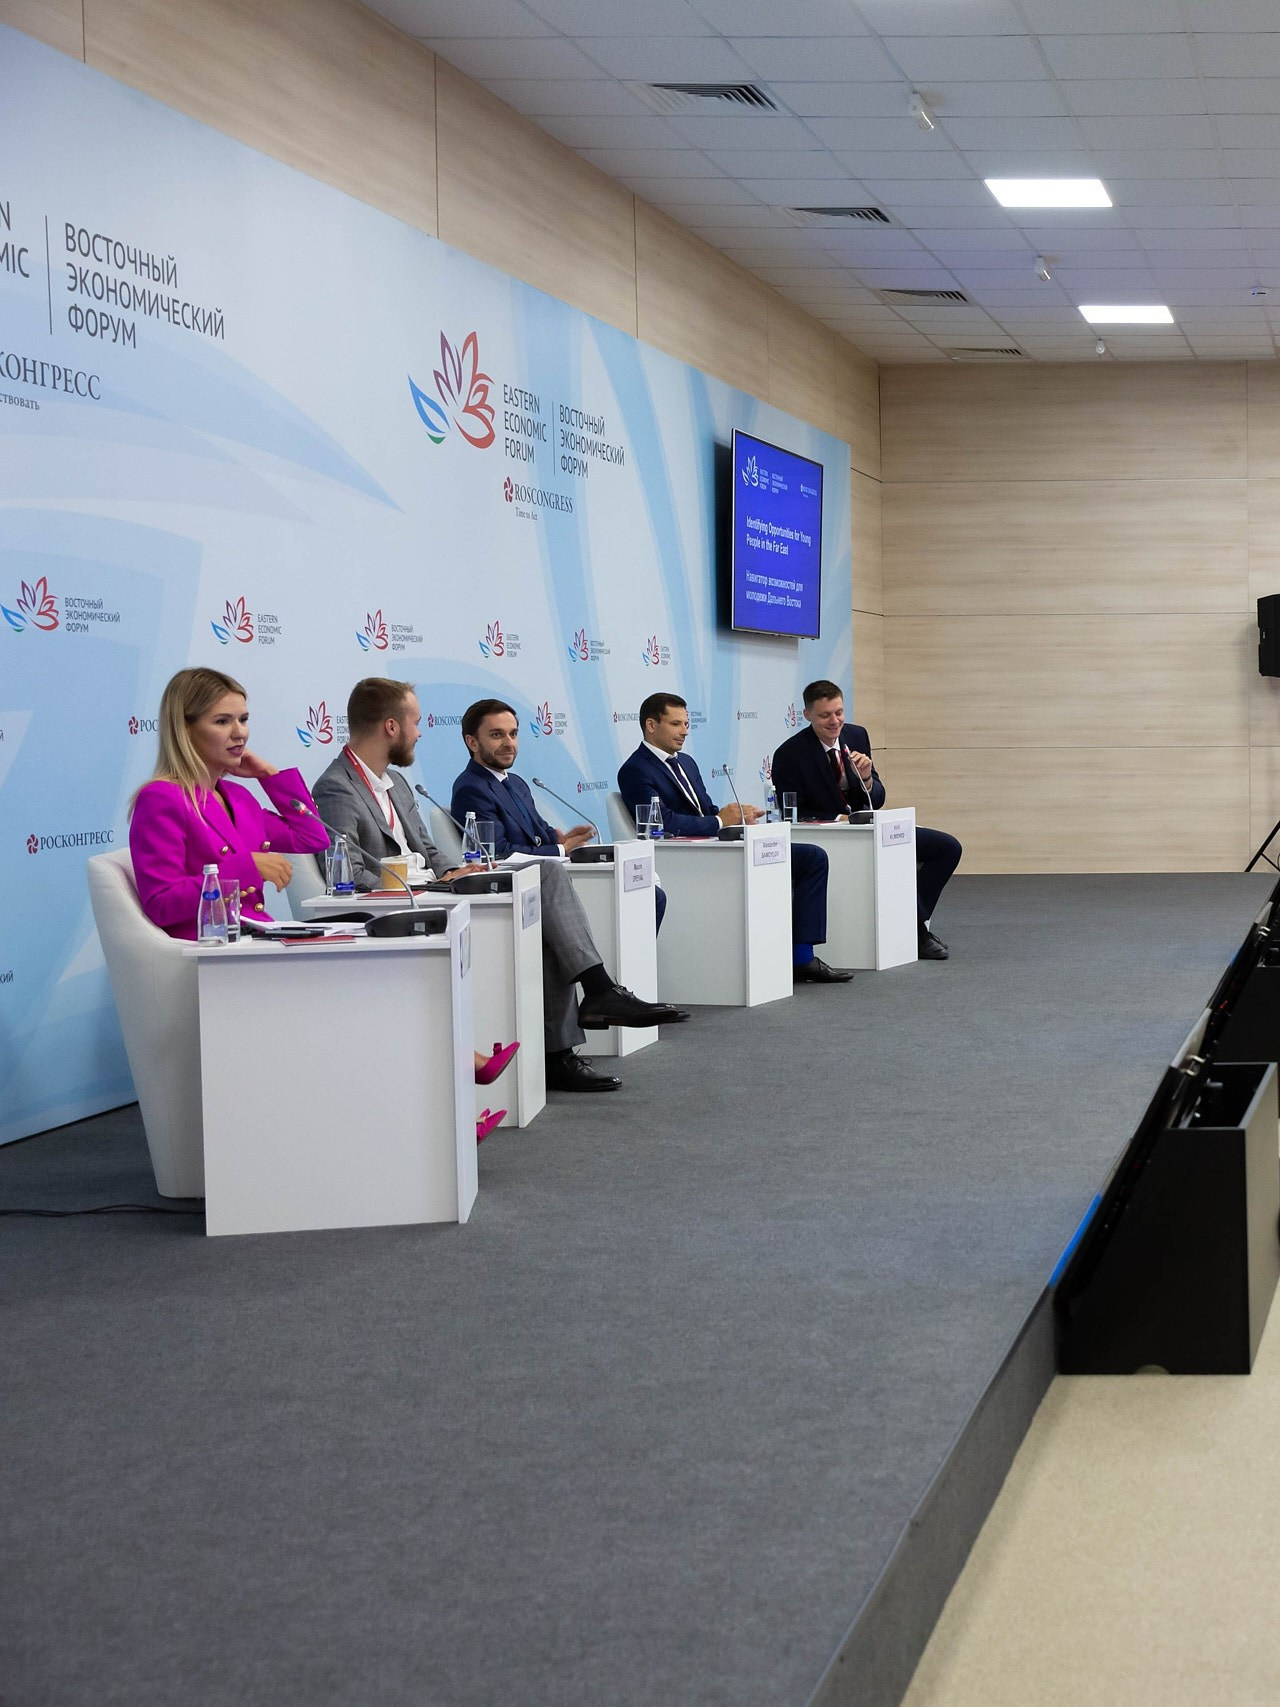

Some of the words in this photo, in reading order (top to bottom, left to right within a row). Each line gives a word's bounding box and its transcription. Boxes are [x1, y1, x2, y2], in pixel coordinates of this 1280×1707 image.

[65, 222, 178, 288] ВОСТОЧНЫЙ
[66, 262, 225, 340] ЭКОНОМИЧЕСКИЙ
[68, 303, 136, 349] ФОРУМ
[0, 392, 40, 410] твовать
[503, 384, 540, 414] EASTERN
[504, 411, 547, 442] ECONOMIC
[560, 404, 605, 437] ВОСТОЧНЫЙ
[505, 437, 535, 464] FORUM
[560, 429, 625, 466] ЭКОНОМИЧЕСКИЙ
[560, 454, 589, 479] ФОРУМ
[515, 484, 573, 513] ROSCONGRESS
[746, 533, 761, 549] People
[780, 542, 789, 555] East
[65, 597, 103, 609] ВОСТОЧНЫЙ
[65, 610, 120, 623] ЭКОНОМИЧЕСКИЙ
[66, 623, 89, 632] ФОРУМ
[257, 613, 278, 624] EASTERN
[257, 624, 282, 635] ECONOMIC
[258, 635, 275, 645] FORUM
[434, 716, 462, 726] ROSCONG
[40, 830, 114, 850] РОСКОНГРЕСС
